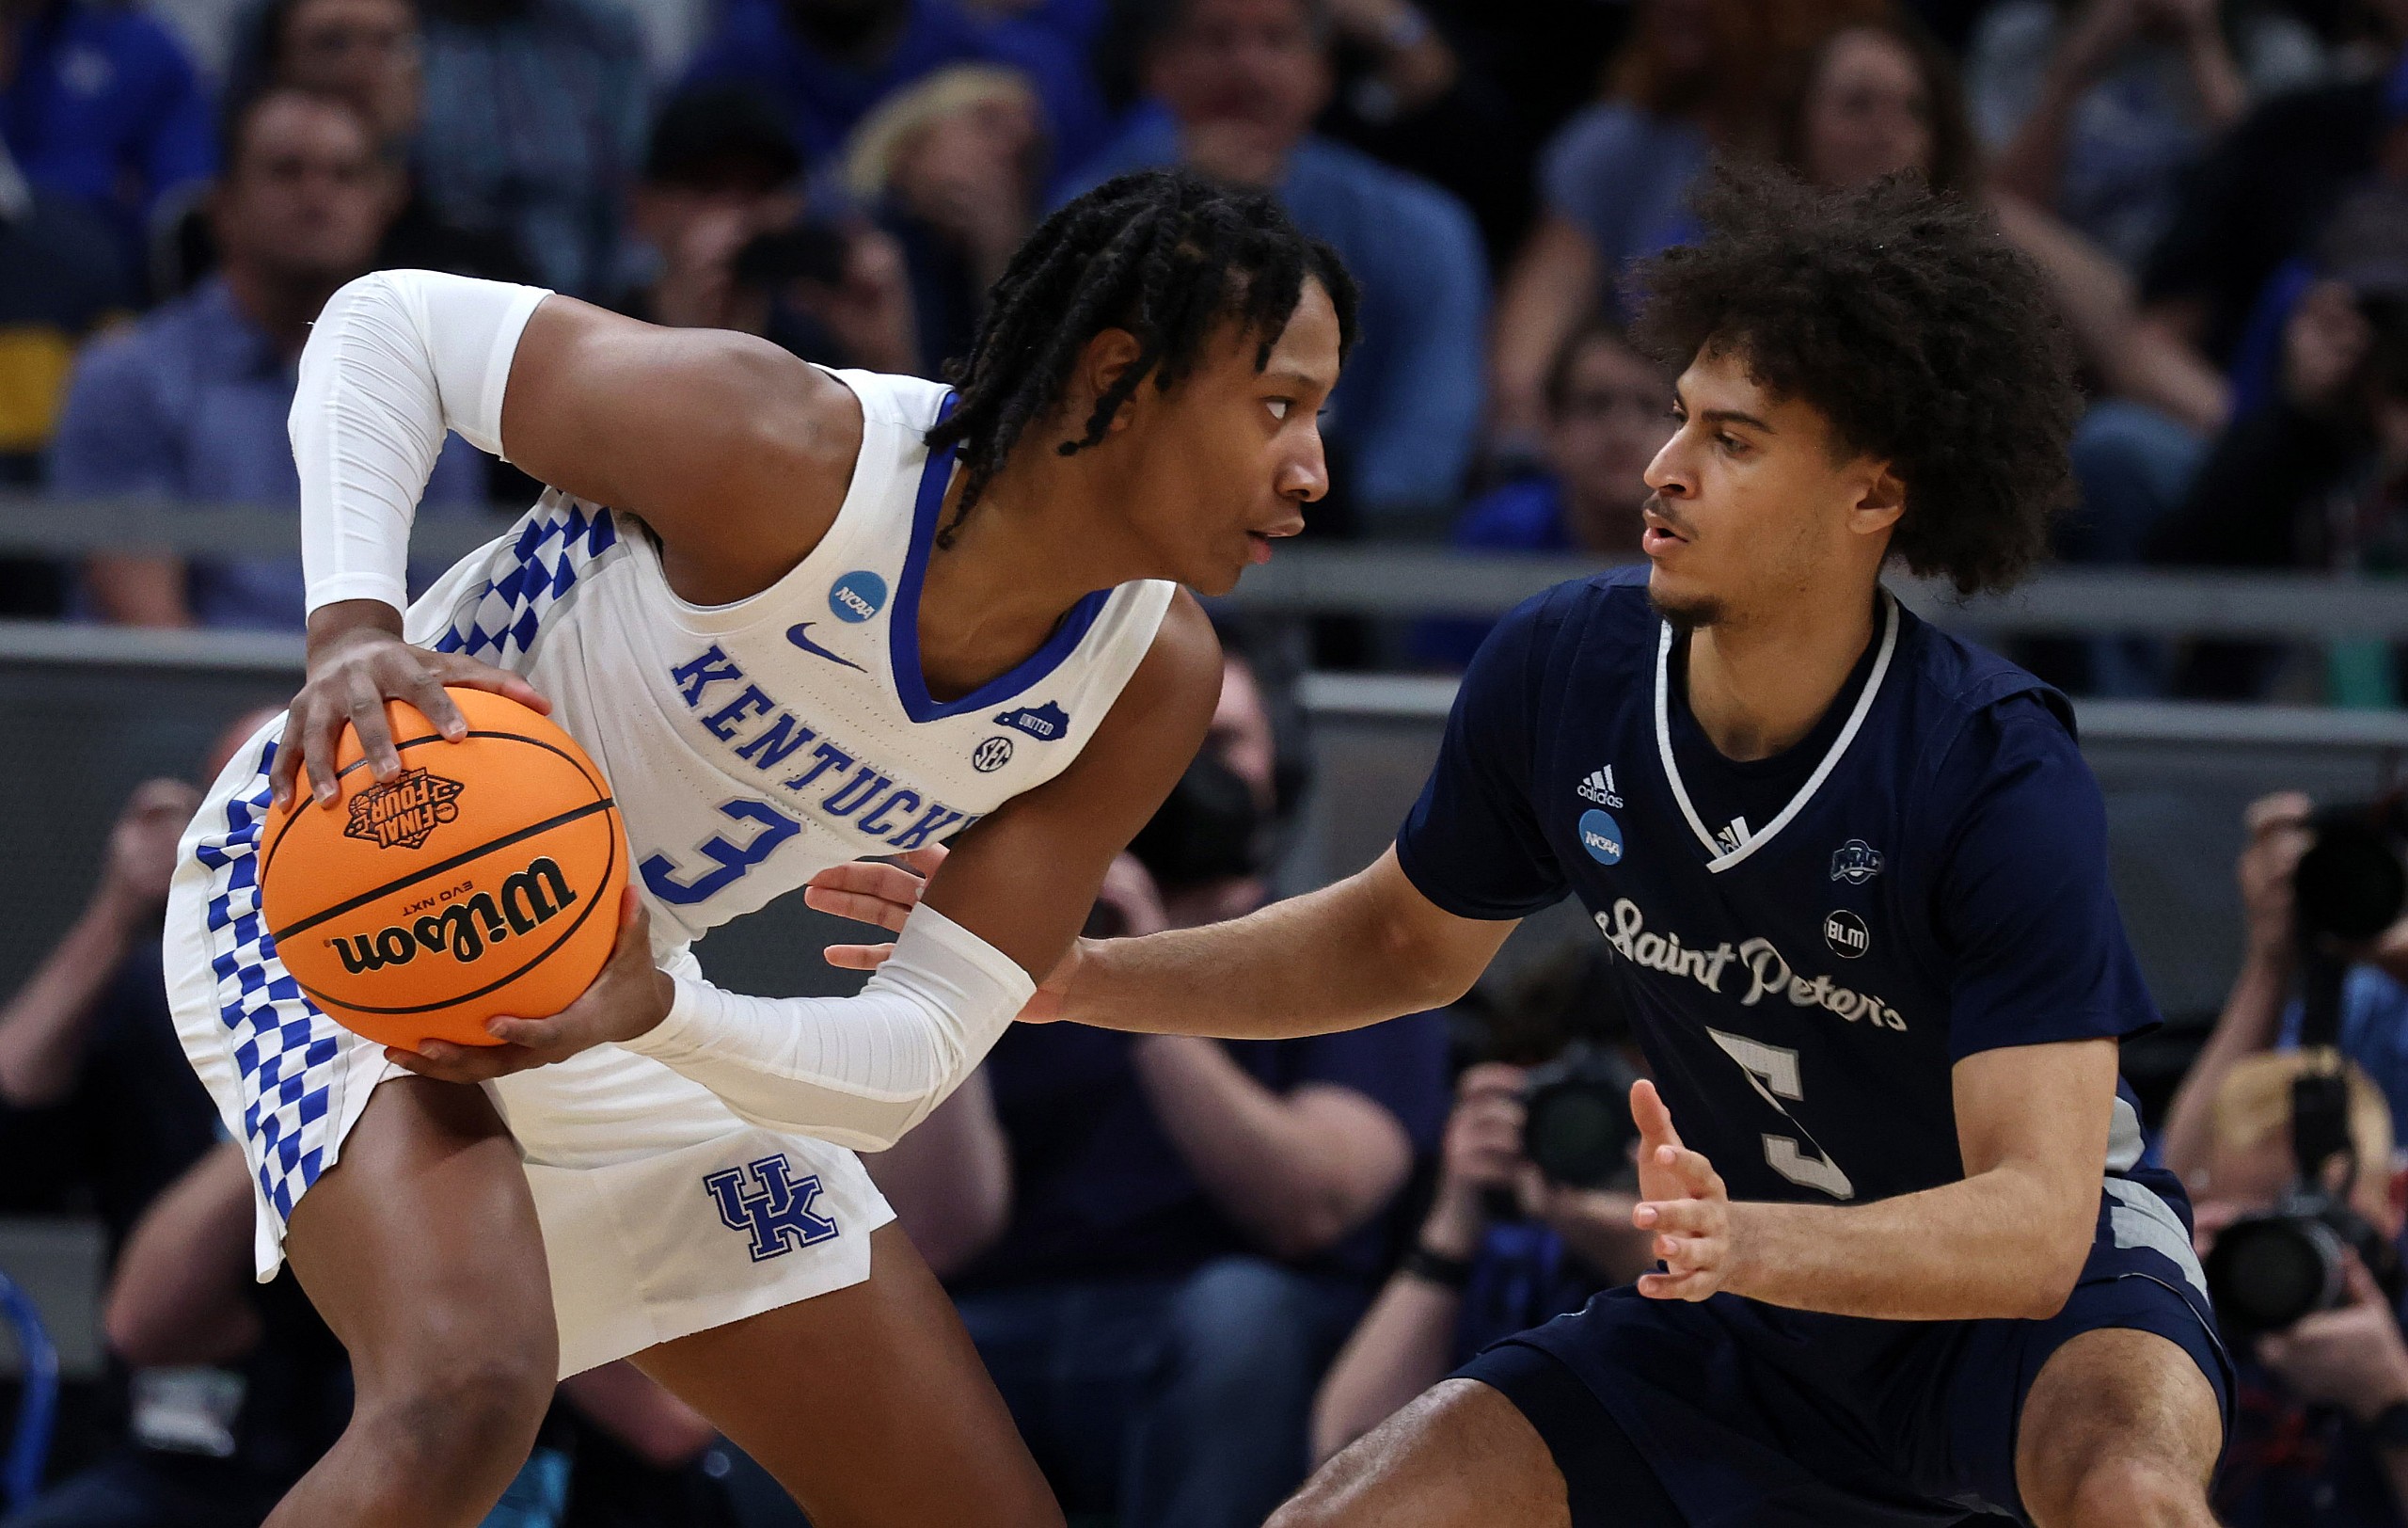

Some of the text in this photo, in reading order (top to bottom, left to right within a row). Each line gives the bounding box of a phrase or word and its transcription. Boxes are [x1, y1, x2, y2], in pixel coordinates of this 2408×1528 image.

[835, 586, 875, 620] NCAA
[1018, 712, 1054, 736] UNITED
[974, 737, 1013, 772] SEC
[372, 780, 430, 824] FOUR
[1576, 784, 1624, 809] adidas
[374, 804, 436, 848] FINAL
[1585, 830, 1621, 858] NCAA
[638, 795, 808, 906] 3
[329, 855, 578, 975] Wilson
[403, 880, 474, 917] EVO NXT
[1828, 919, 1865, 949] BLM
[1594, 897, 1909, 1032] Saint Peter's
[1705, 1025, 1856, 1202] 5
[703, 1153, 840, 1263] UK
